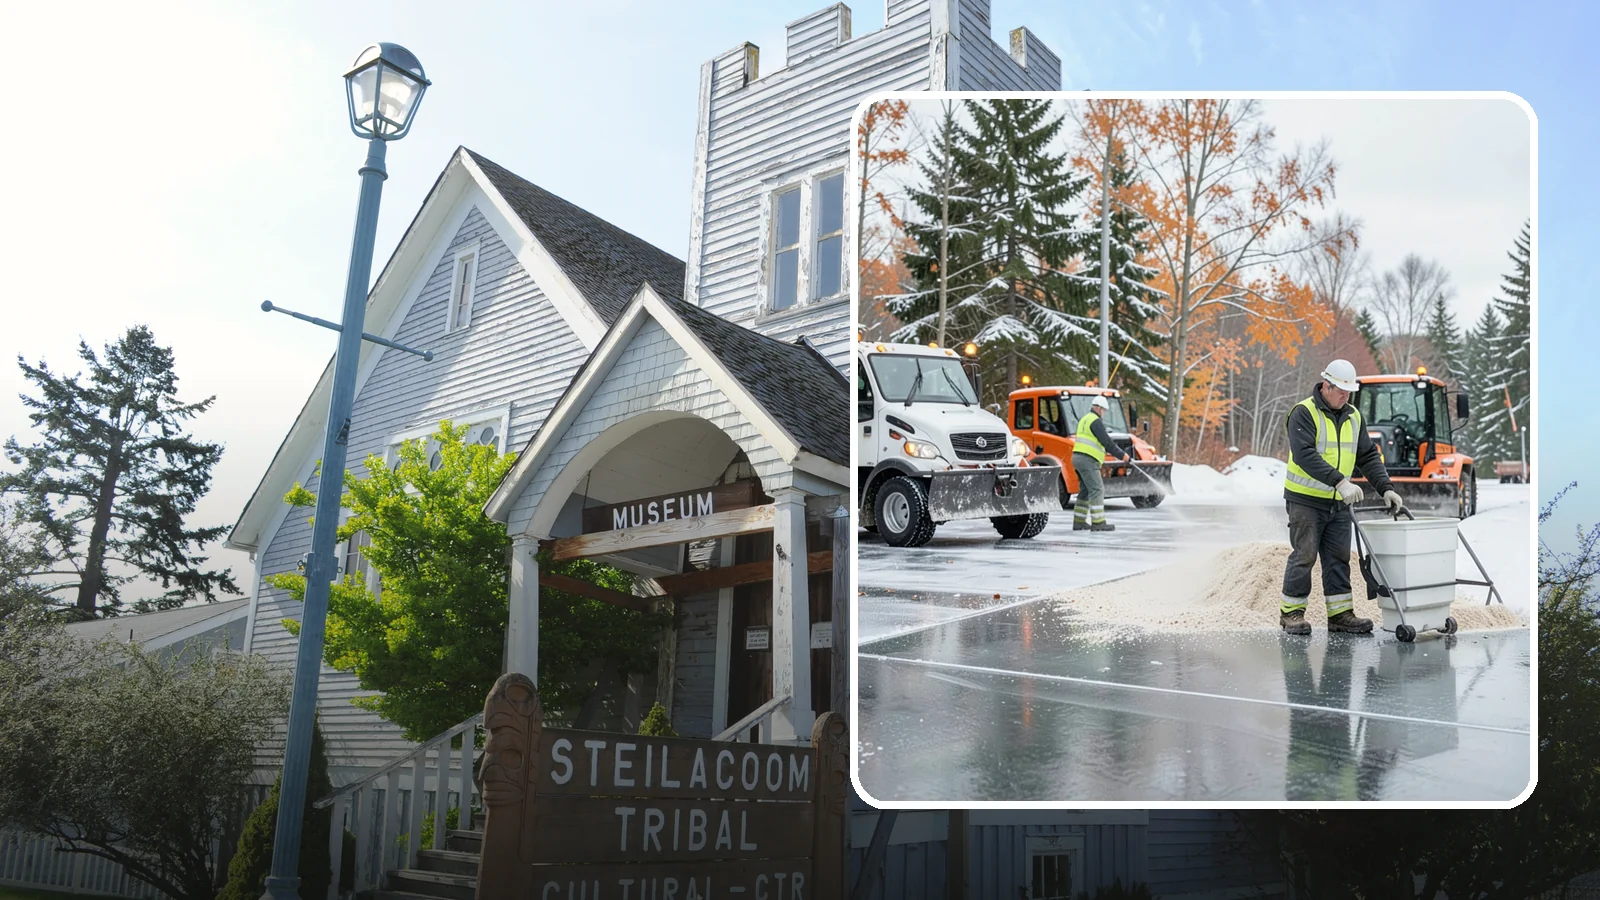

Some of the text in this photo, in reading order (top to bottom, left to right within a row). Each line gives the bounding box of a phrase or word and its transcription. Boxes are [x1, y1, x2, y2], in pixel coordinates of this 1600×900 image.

[613, 492, 714, 530] MUSEUM
[550, 738, 809, 792] STEILACOOM
[614, 807, 758, 852] TRIBAL
